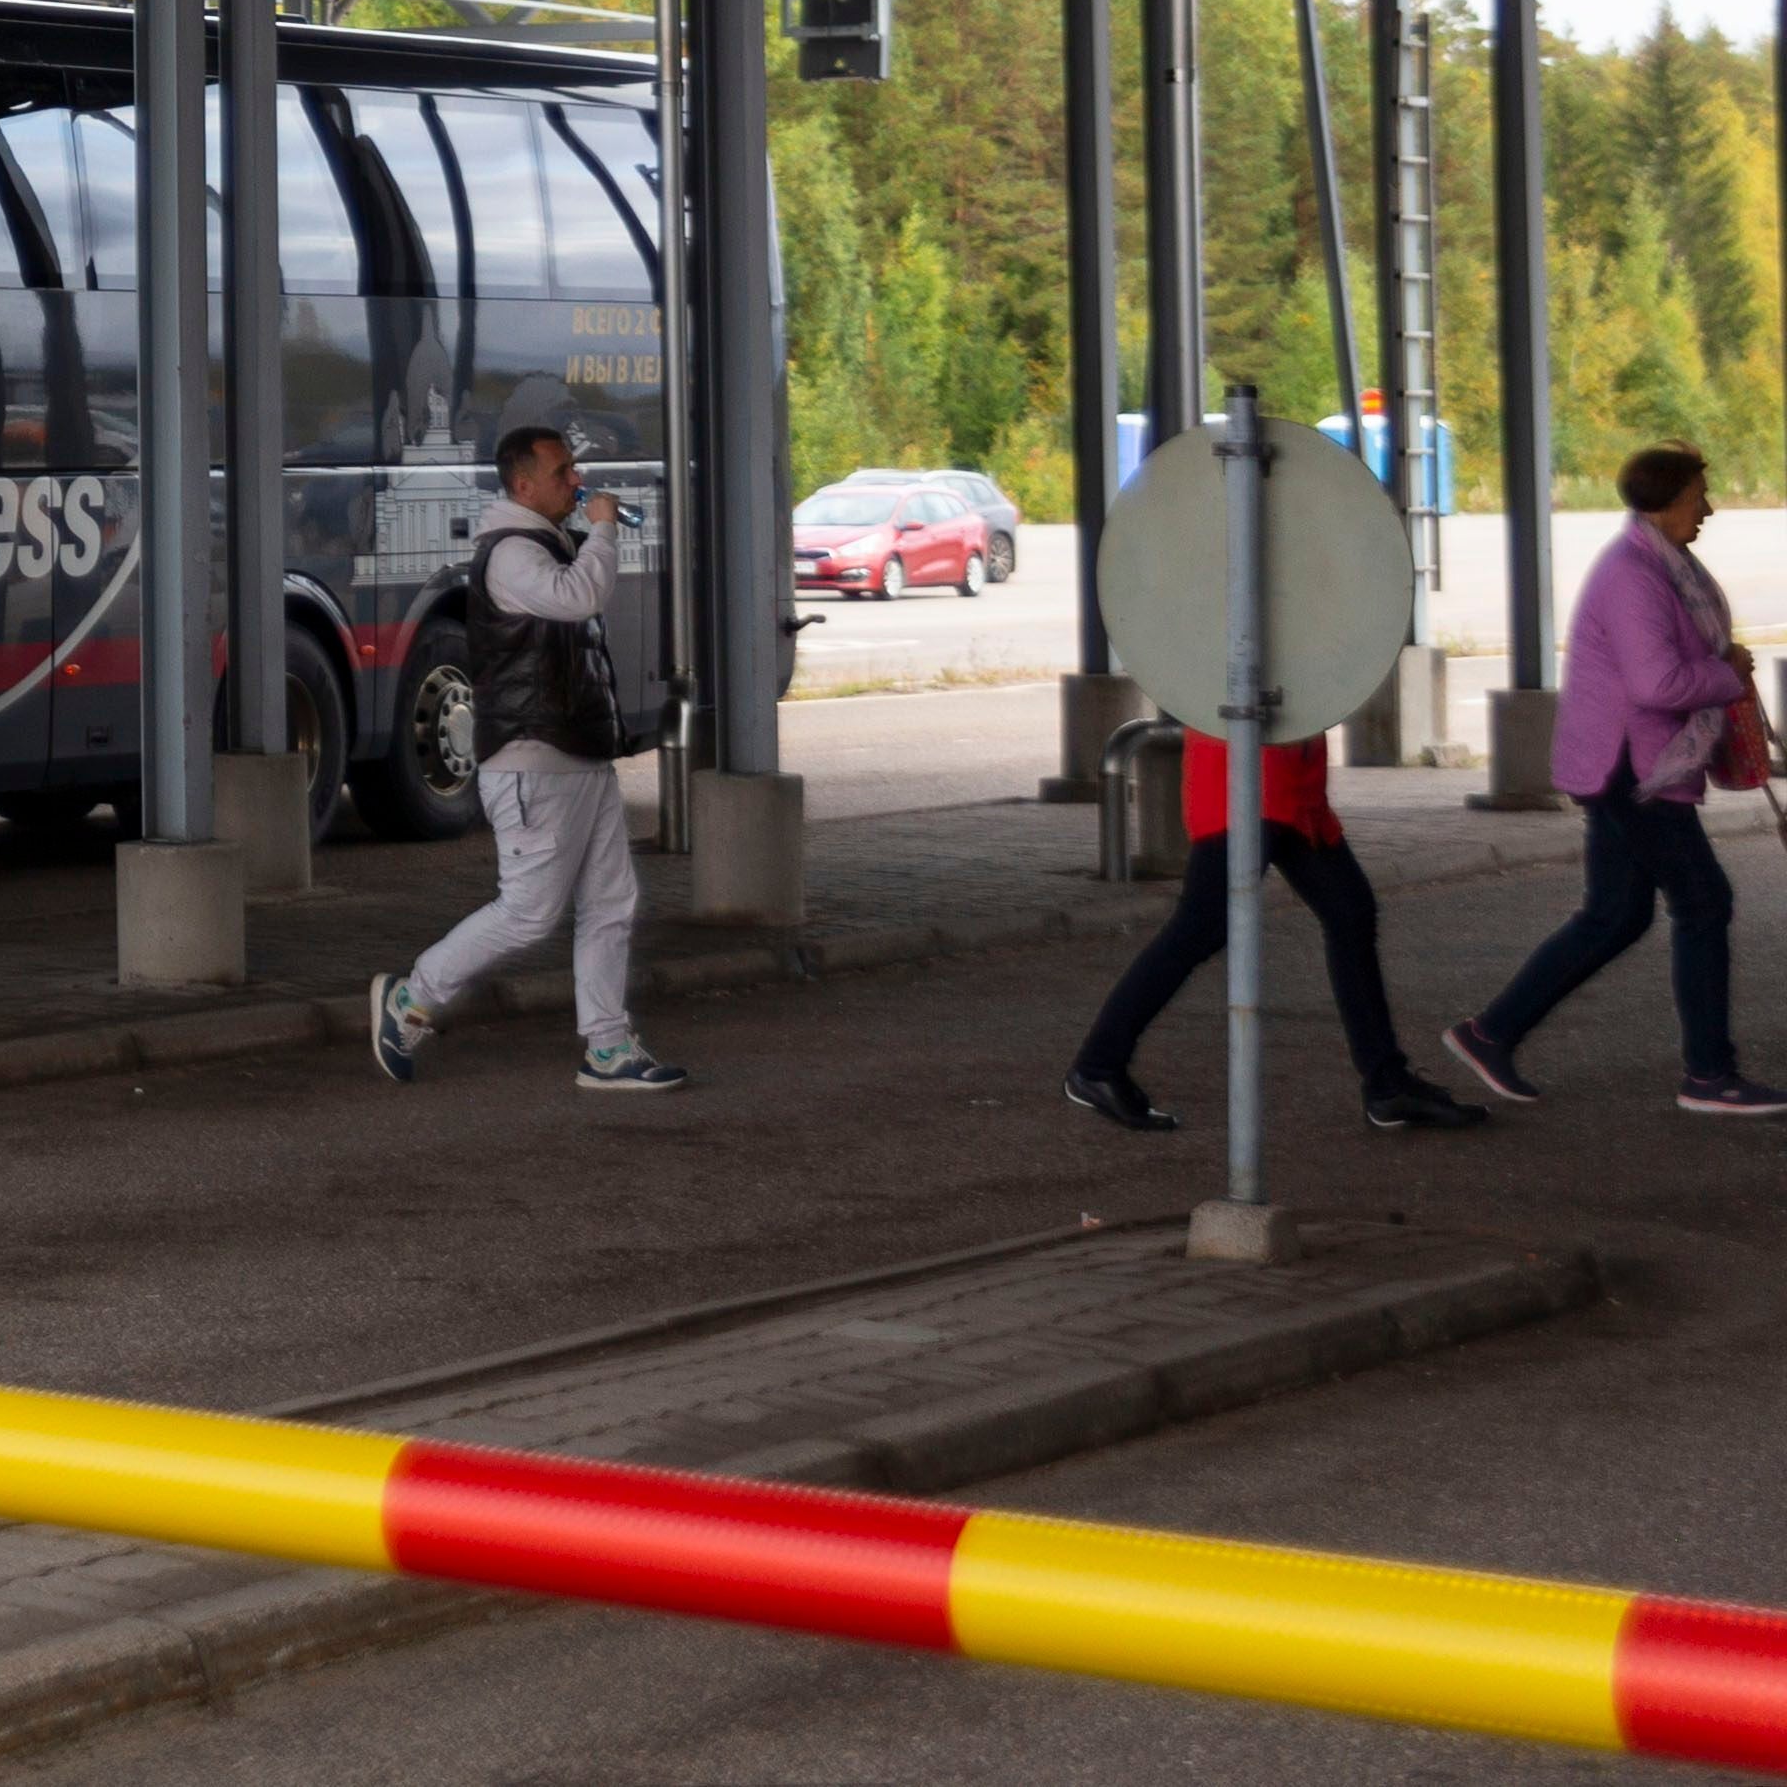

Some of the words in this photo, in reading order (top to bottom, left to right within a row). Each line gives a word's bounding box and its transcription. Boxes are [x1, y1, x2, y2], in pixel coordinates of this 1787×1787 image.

[572, 307, 631, 335] ВСЕГО
[635, 310, 646, 335] 2
[566, 356, 580, 383] И
[583, 356, 612, 383] ВЫ
[616, 356, 628, 383] В
